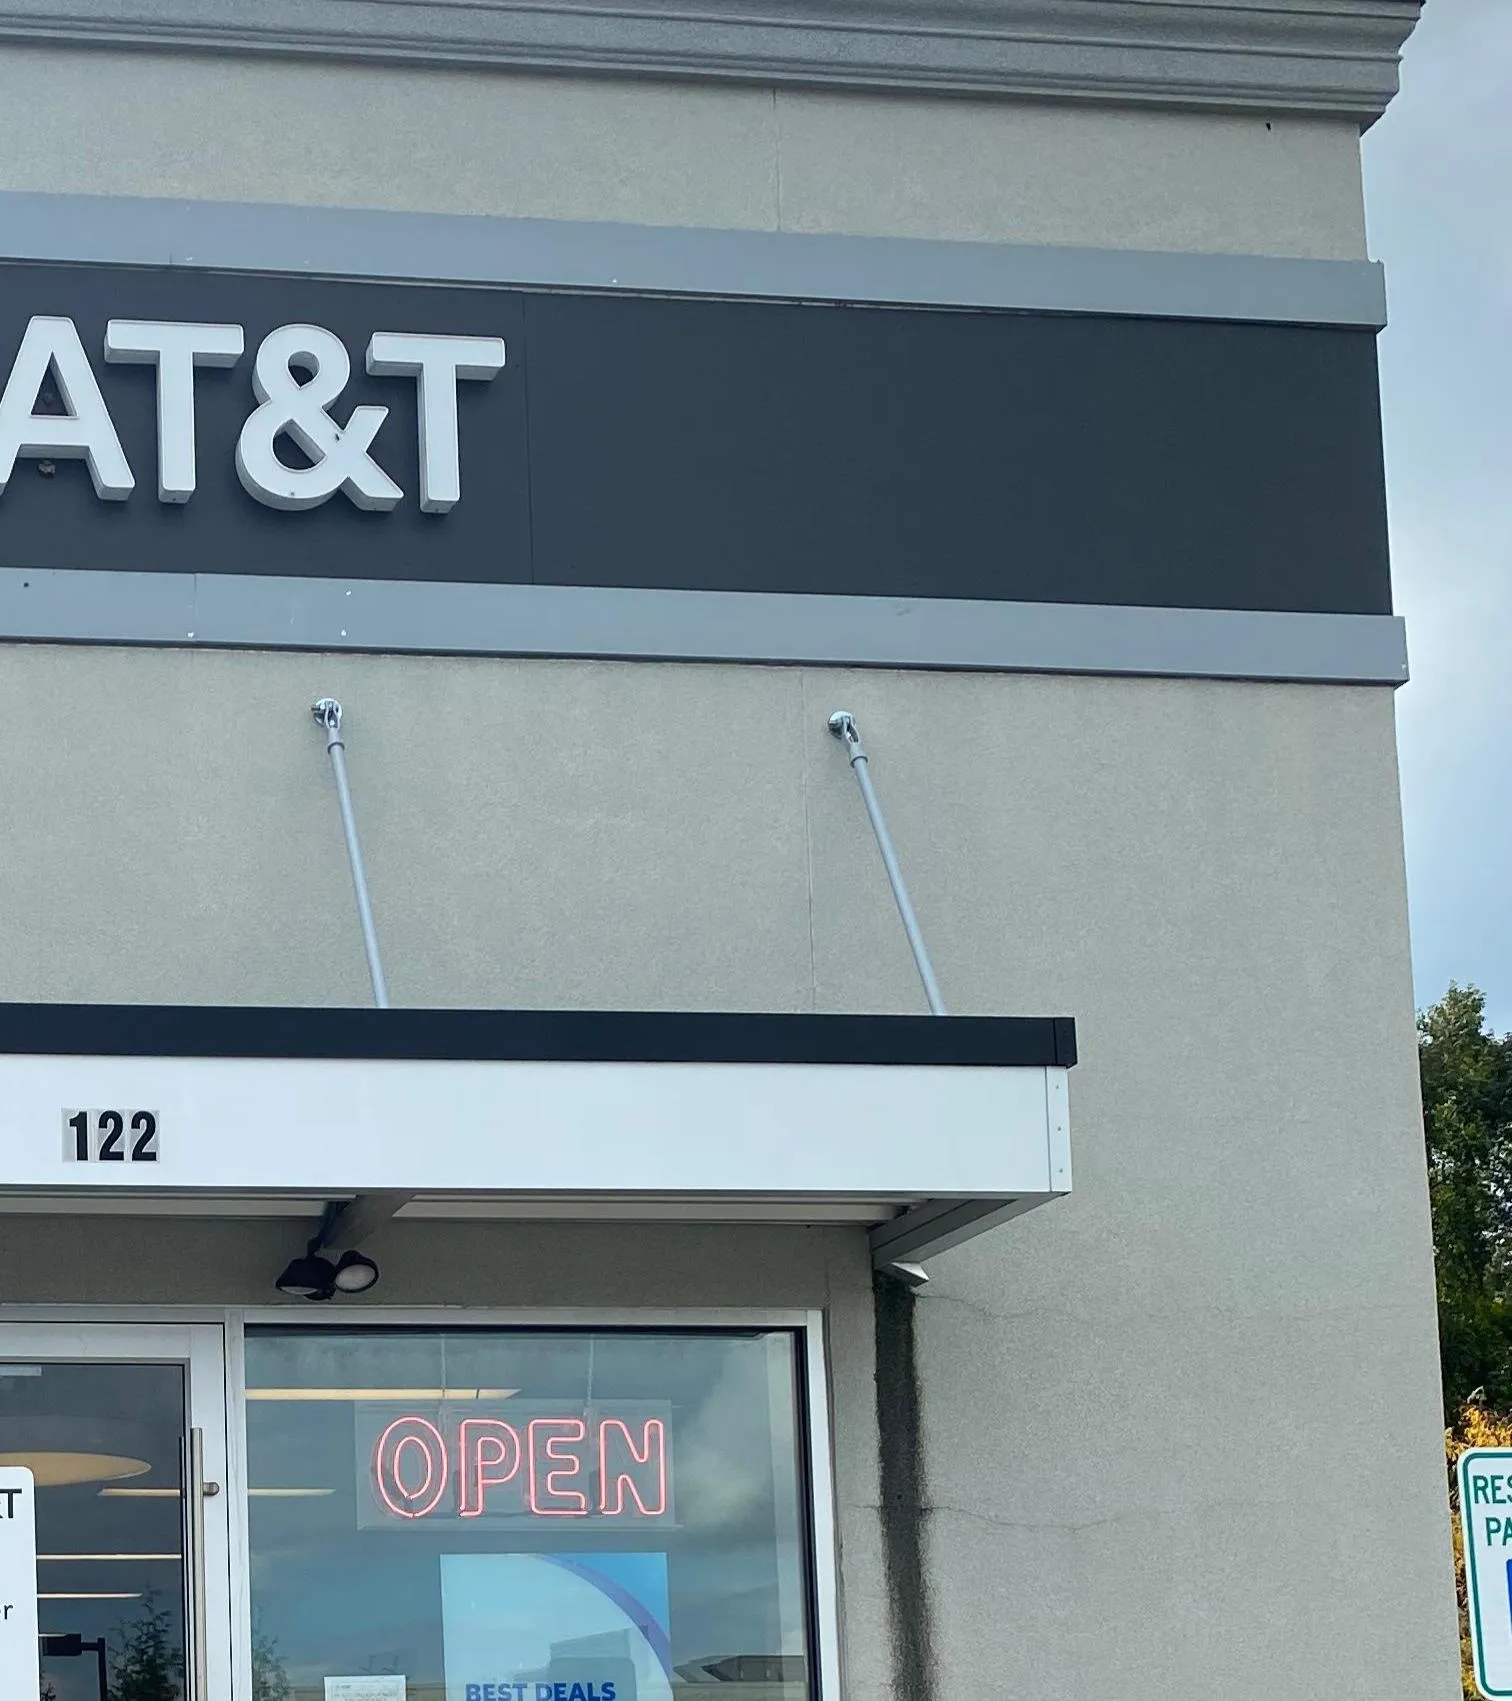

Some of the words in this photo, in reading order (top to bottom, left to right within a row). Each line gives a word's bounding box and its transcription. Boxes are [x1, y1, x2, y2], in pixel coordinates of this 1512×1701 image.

[69, 1110, 157, 1161] 122
[374, 1416, 668, 1518] OPEN
[465, 1683, 528, 1701] BEST
[535, 1682, 616, 1701] DEALS
